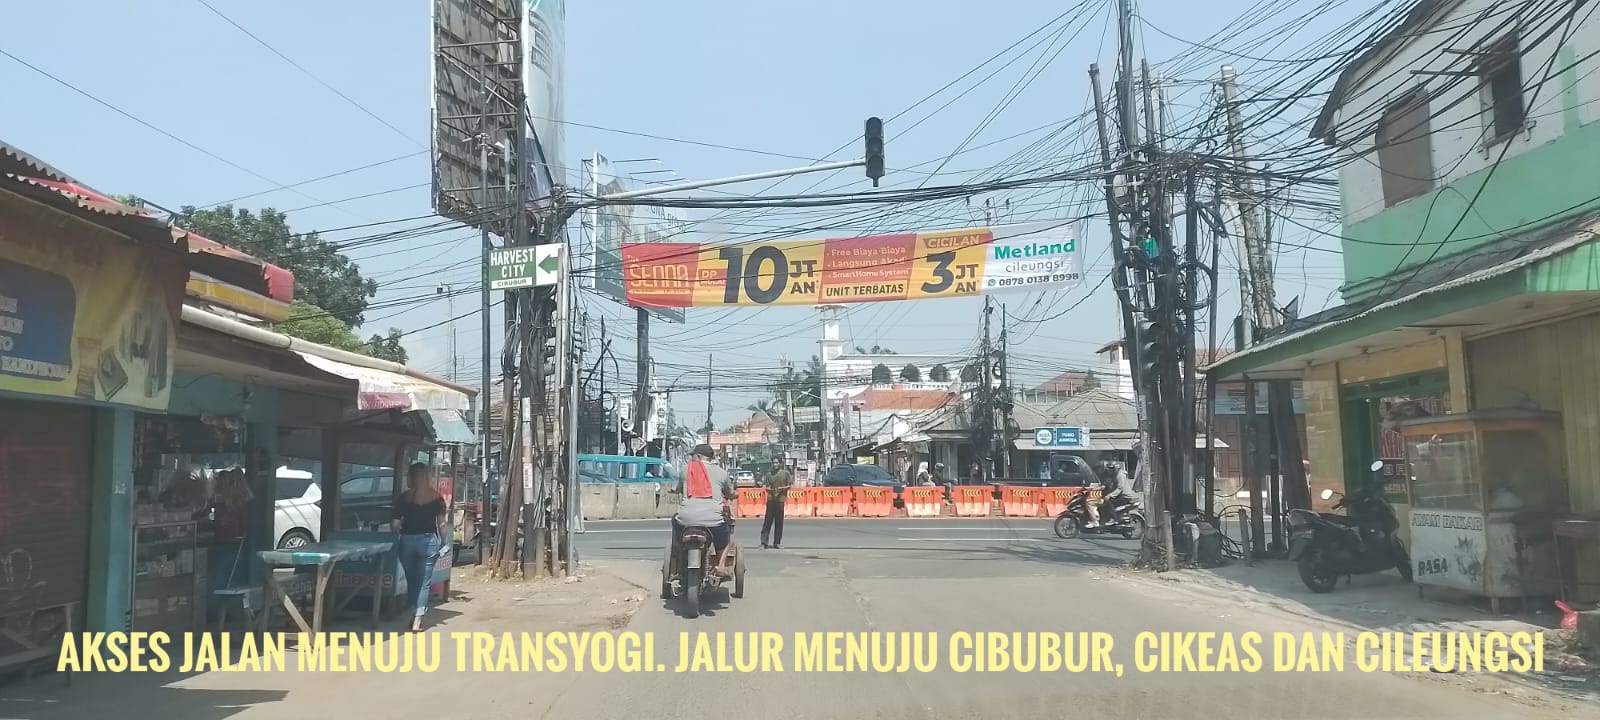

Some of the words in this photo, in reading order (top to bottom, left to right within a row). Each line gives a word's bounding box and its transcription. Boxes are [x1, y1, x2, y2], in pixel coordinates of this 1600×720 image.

[927, 235, 980, 248] CICILAN
[490, 248, 535, 266] HARVEST
[831, 249, 851, 257] Free
[994, 239, 1076, 260] Metland
[501, 264, 526, 278] CITY
[790, 260, 817, 278] JT
[921, 250, 956, 293] 3
[955, 264, 979, 279] JT
[1005, 260, 1064, 273] cileungsi
[702, 270, 717, 279] DP
[719, 245, 788, 304] 10
[998, 277, 1024, 286] 0878
[1026, 275, 1050, 284] 0138
[1052, 272, 1079, 281] 8998
[826, 286, 851, 297] UNIT
[853, 284, 904, 296] TERBATAS
[1442, 515, 1483, 531] BAKAR
[1418, 558, 1449, 577] RASA
